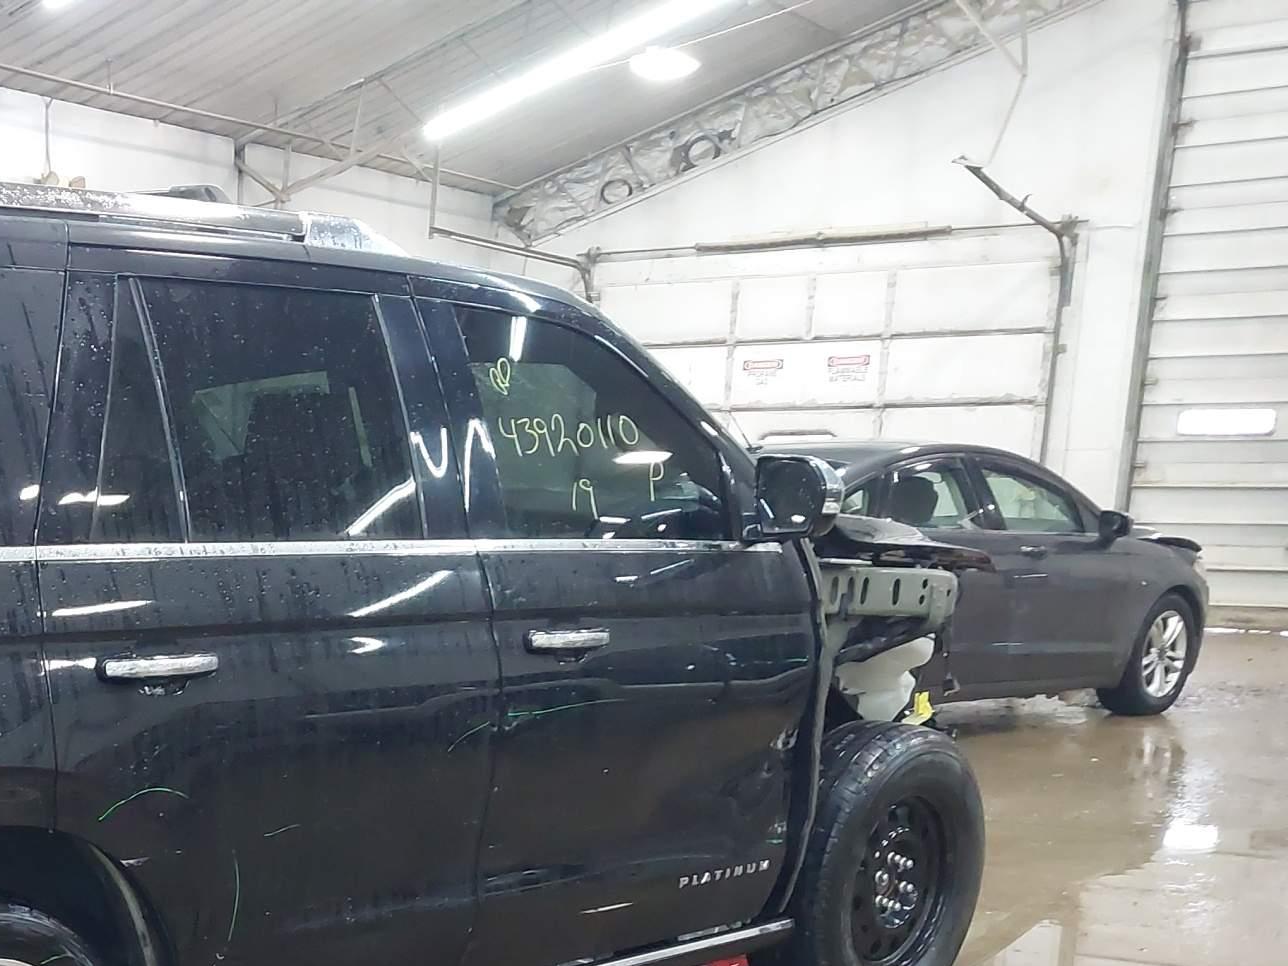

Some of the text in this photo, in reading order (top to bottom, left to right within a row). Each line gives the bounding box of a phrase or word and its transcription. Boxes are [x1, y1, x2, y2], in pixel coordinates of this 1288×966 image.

[498, 413, 639, 457] 43920110
[572, 478, 599, 520] 19
[679, 859, 770, 888] PLATINUM
